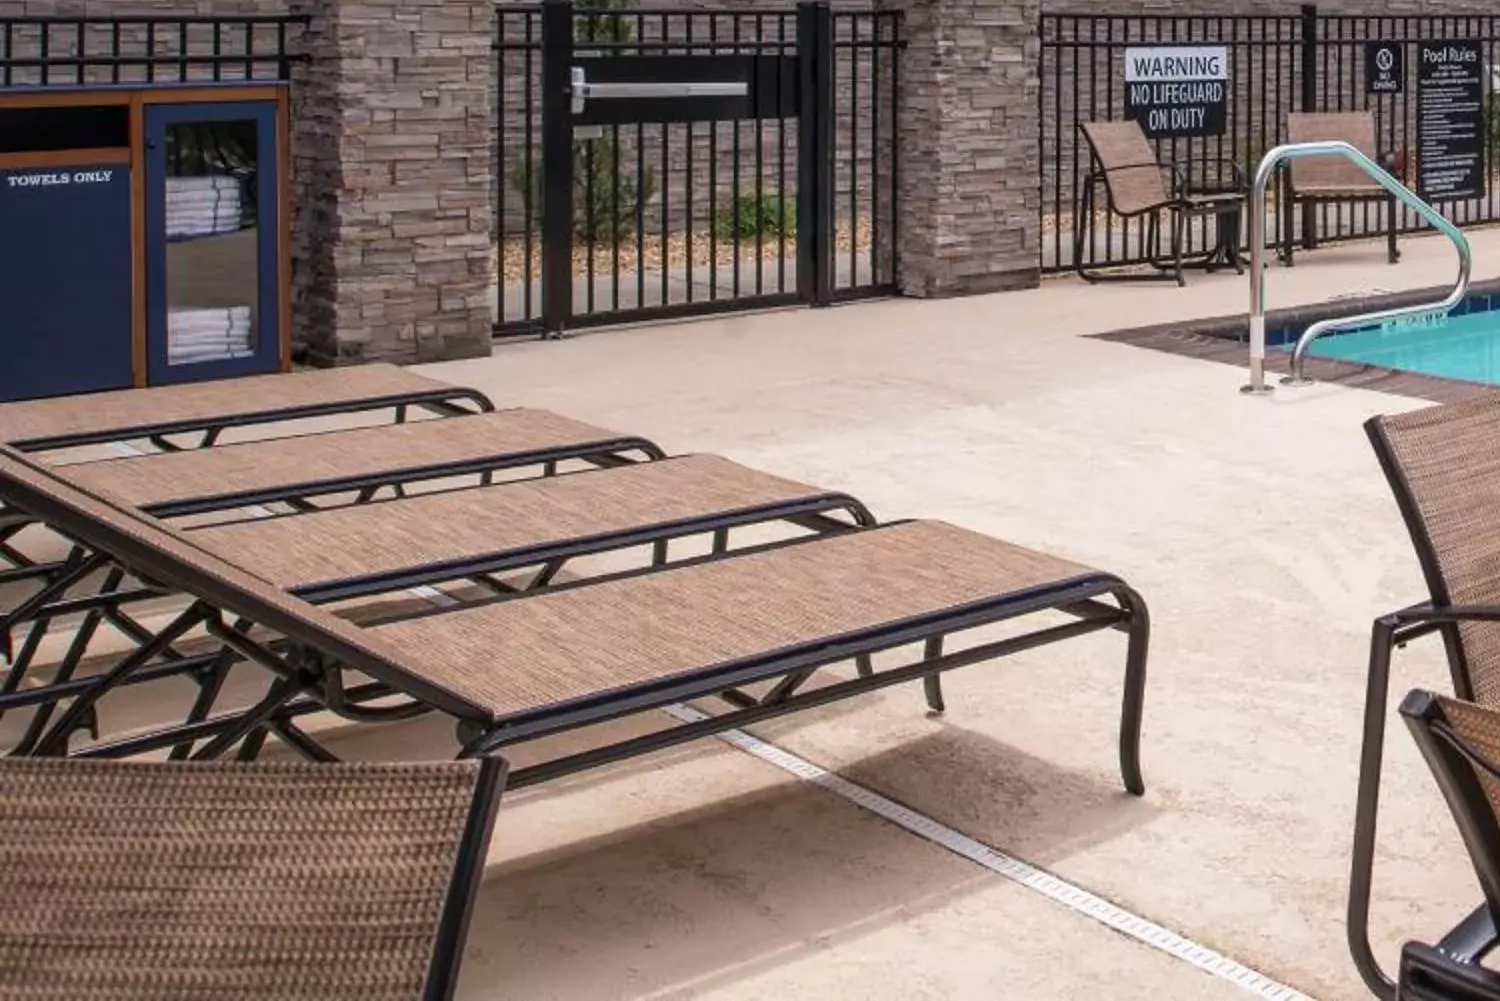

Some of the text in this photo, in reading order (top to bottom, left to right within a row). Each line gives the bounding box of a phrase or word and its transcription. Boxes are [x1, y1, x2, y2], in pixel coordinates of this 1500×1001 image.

[1423, 46, 1477, 63] Pool Rules
[1133, 56, 1219, 76] WARNING
[1131, 82, 1223, 106] NO LIFEGUARD
[1149, 107, 1205, 131] ON DUTY
[7, 170, 113, 187] TOWELS ONLY
